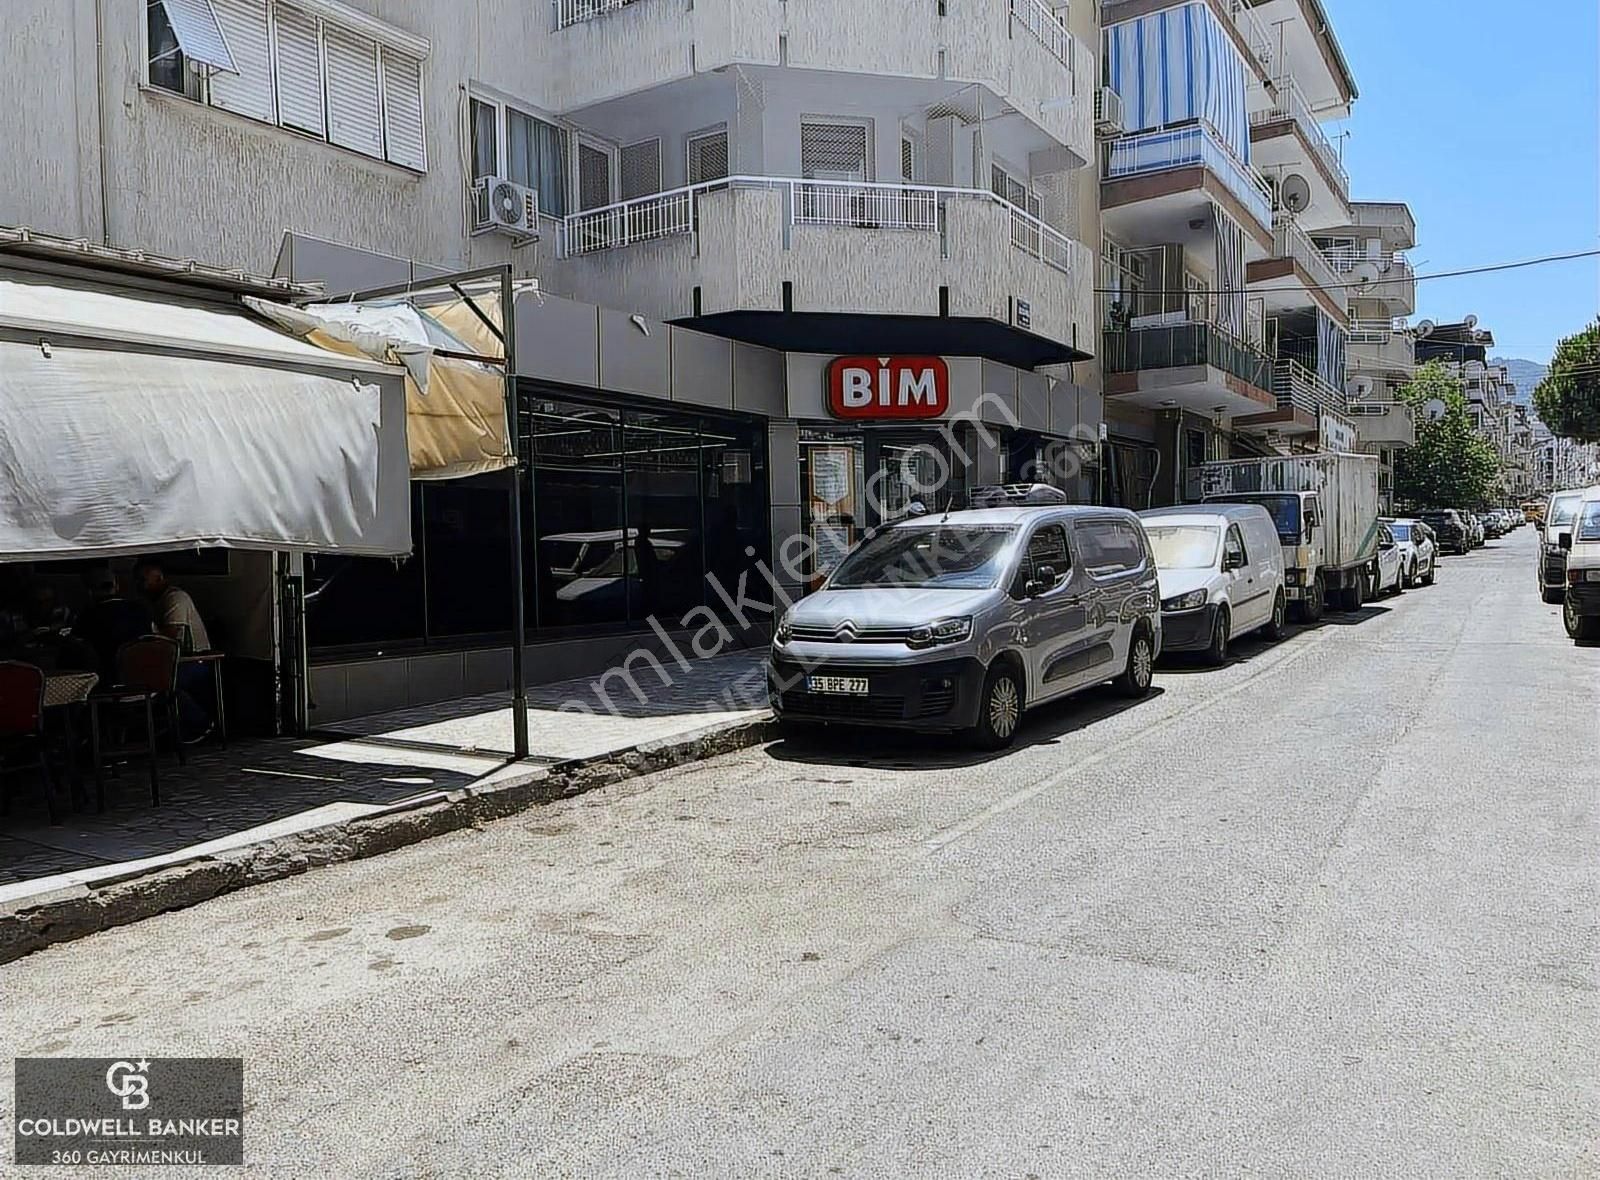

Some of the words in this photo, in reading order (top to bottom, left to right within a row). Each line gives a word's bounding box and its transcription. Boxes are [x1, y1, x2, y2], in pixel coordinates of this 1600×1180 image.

[842, 357, 938, 408] BİM
[811, 677, 824, 690] 35
[848, 679, 867, 692] 277
